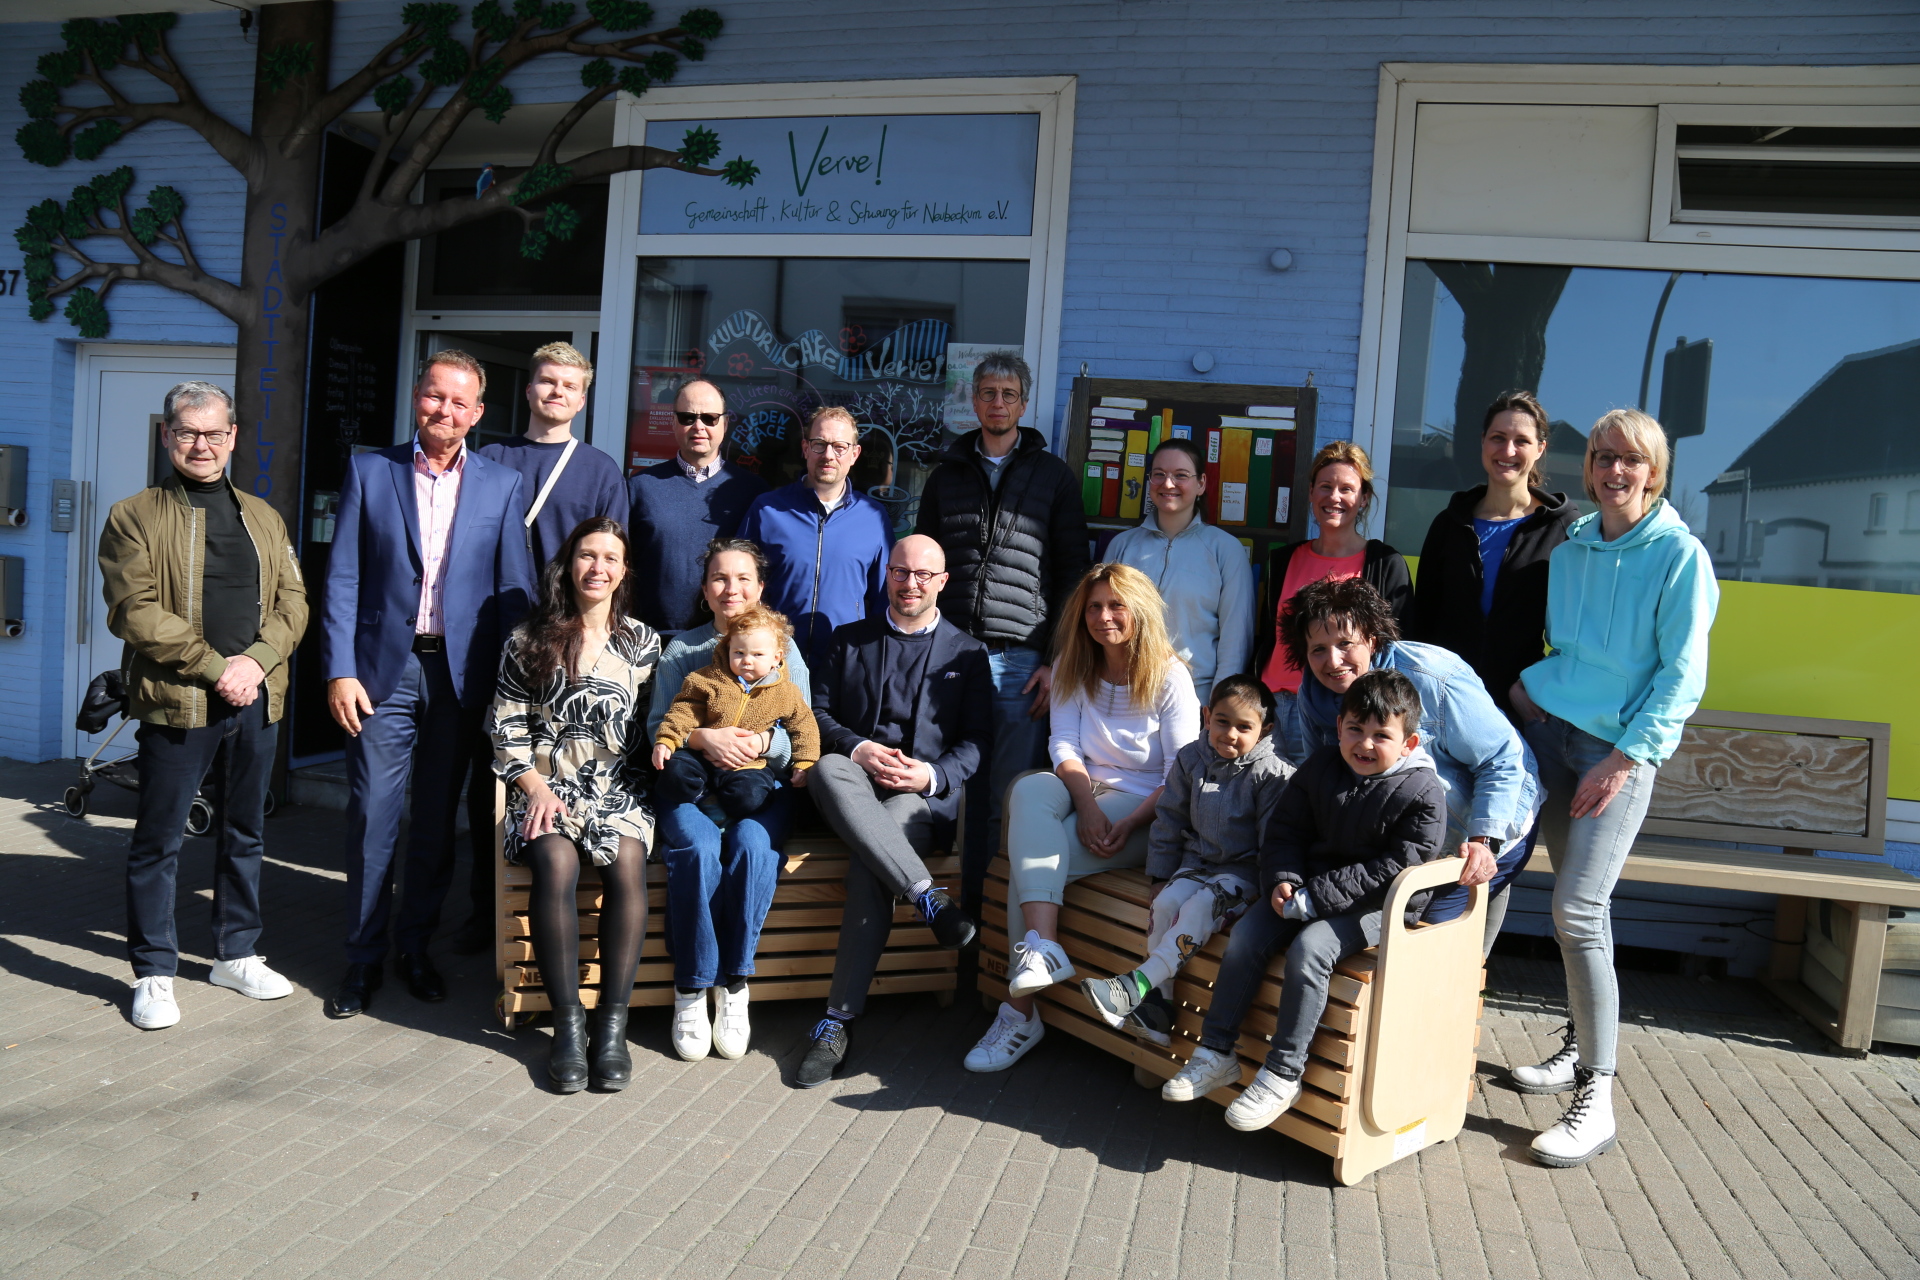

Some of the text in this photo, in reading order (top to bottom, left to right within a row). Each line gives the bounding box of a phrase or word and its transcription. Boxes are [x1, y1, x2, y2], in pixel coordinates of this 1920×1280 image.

[788, 124, 887, 197] Verve!
[780, 199, 823, 222] Kultur
[826, 200, 841, 222] &
[901, 199, 919, 222] für
[922, 202, 982, 224] Neubeckum
[988, 200, 1009, 220] e.V.
[254, 202, 287, 507] STADTTEILWO
[708, 311, 945, 385] KULTUR CAFE Verve!
[797, 390, 814, 424] Tass
[730, 410, 790, 444] FRIEDEN
[740, 424, 786, 456] PEACE
